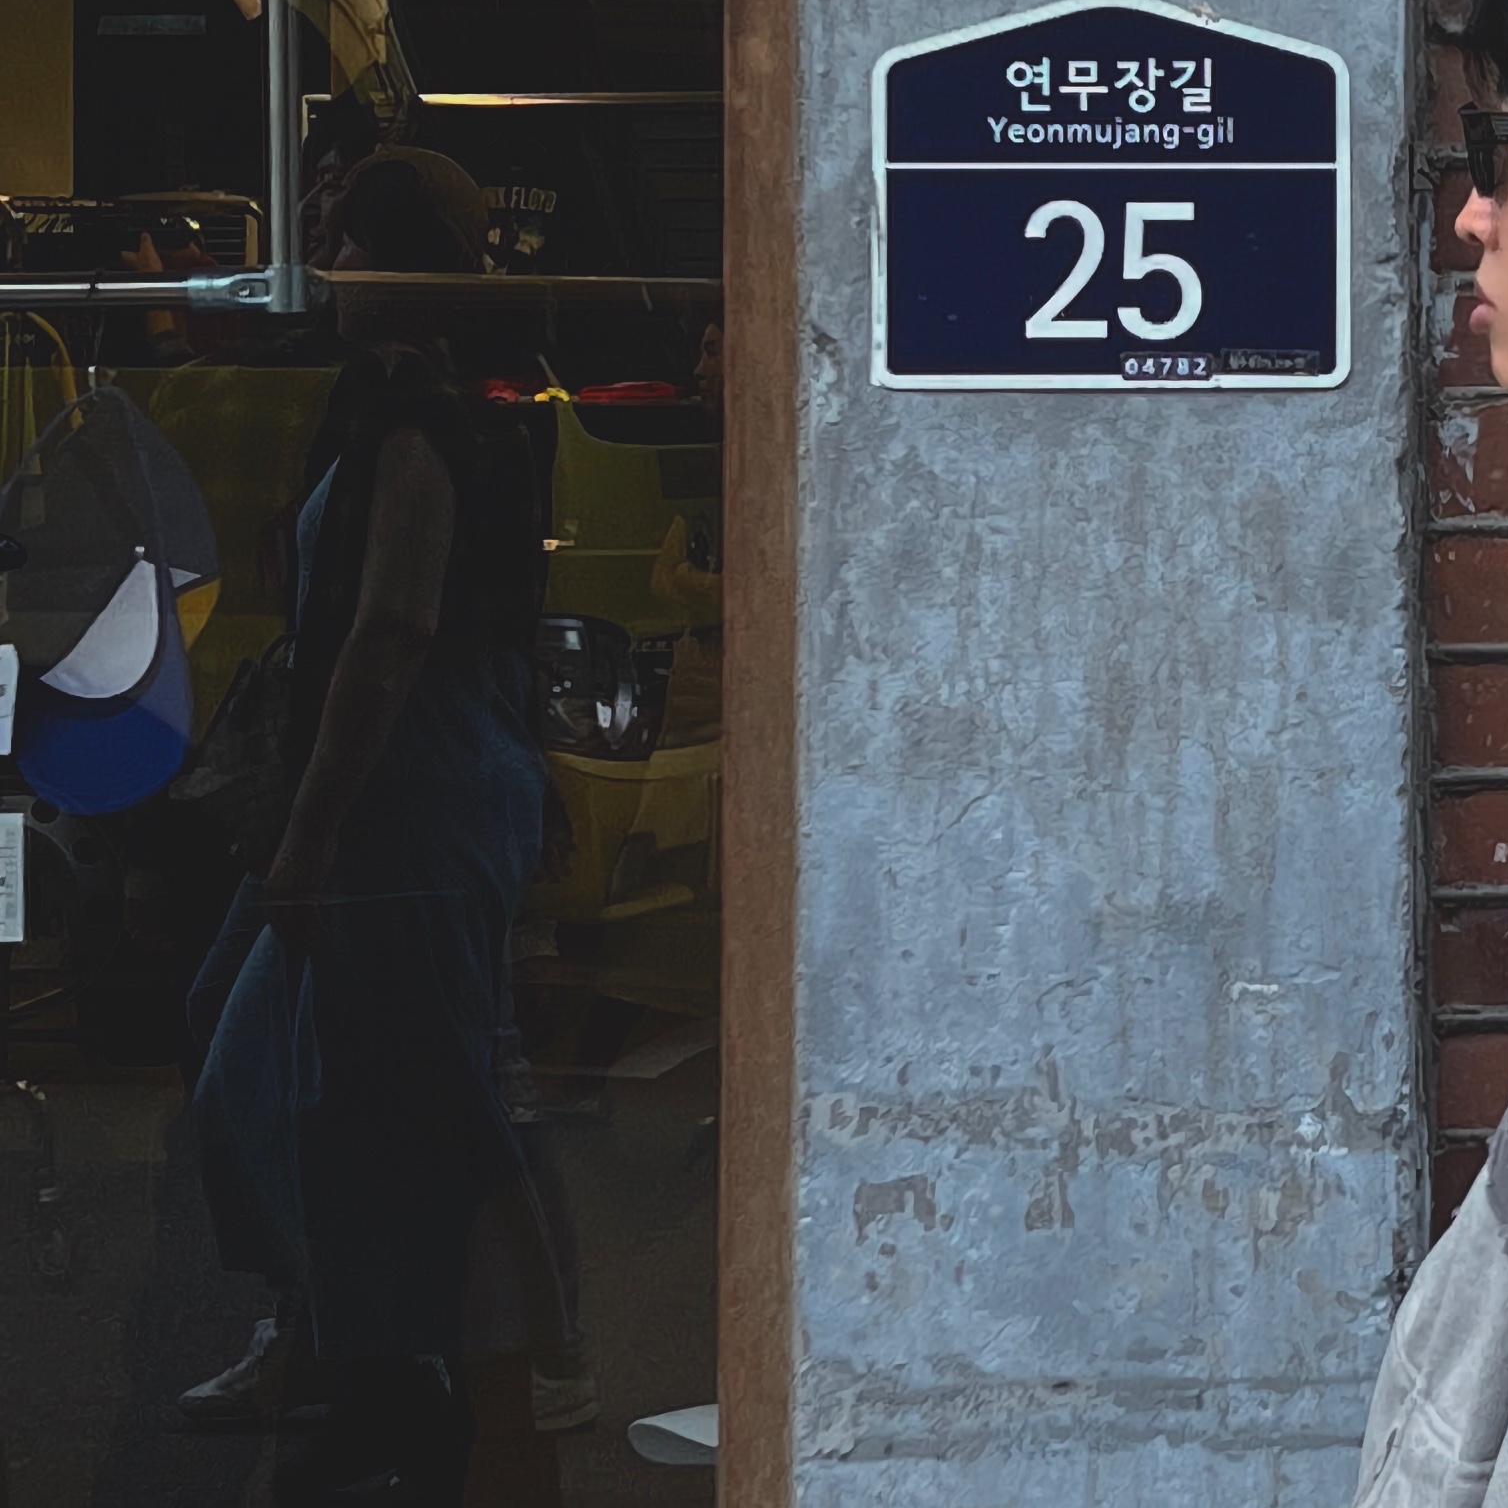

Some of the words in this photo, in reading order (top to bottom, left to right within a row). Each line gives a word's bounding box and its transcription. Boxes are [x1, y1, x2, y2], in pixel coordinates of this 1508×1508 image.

[1005, 56, 1213, 114] 연무장길
[987, 116, 1234, 149] Yeonmujang-gil
[1023, 199, 1203, 341] 25
